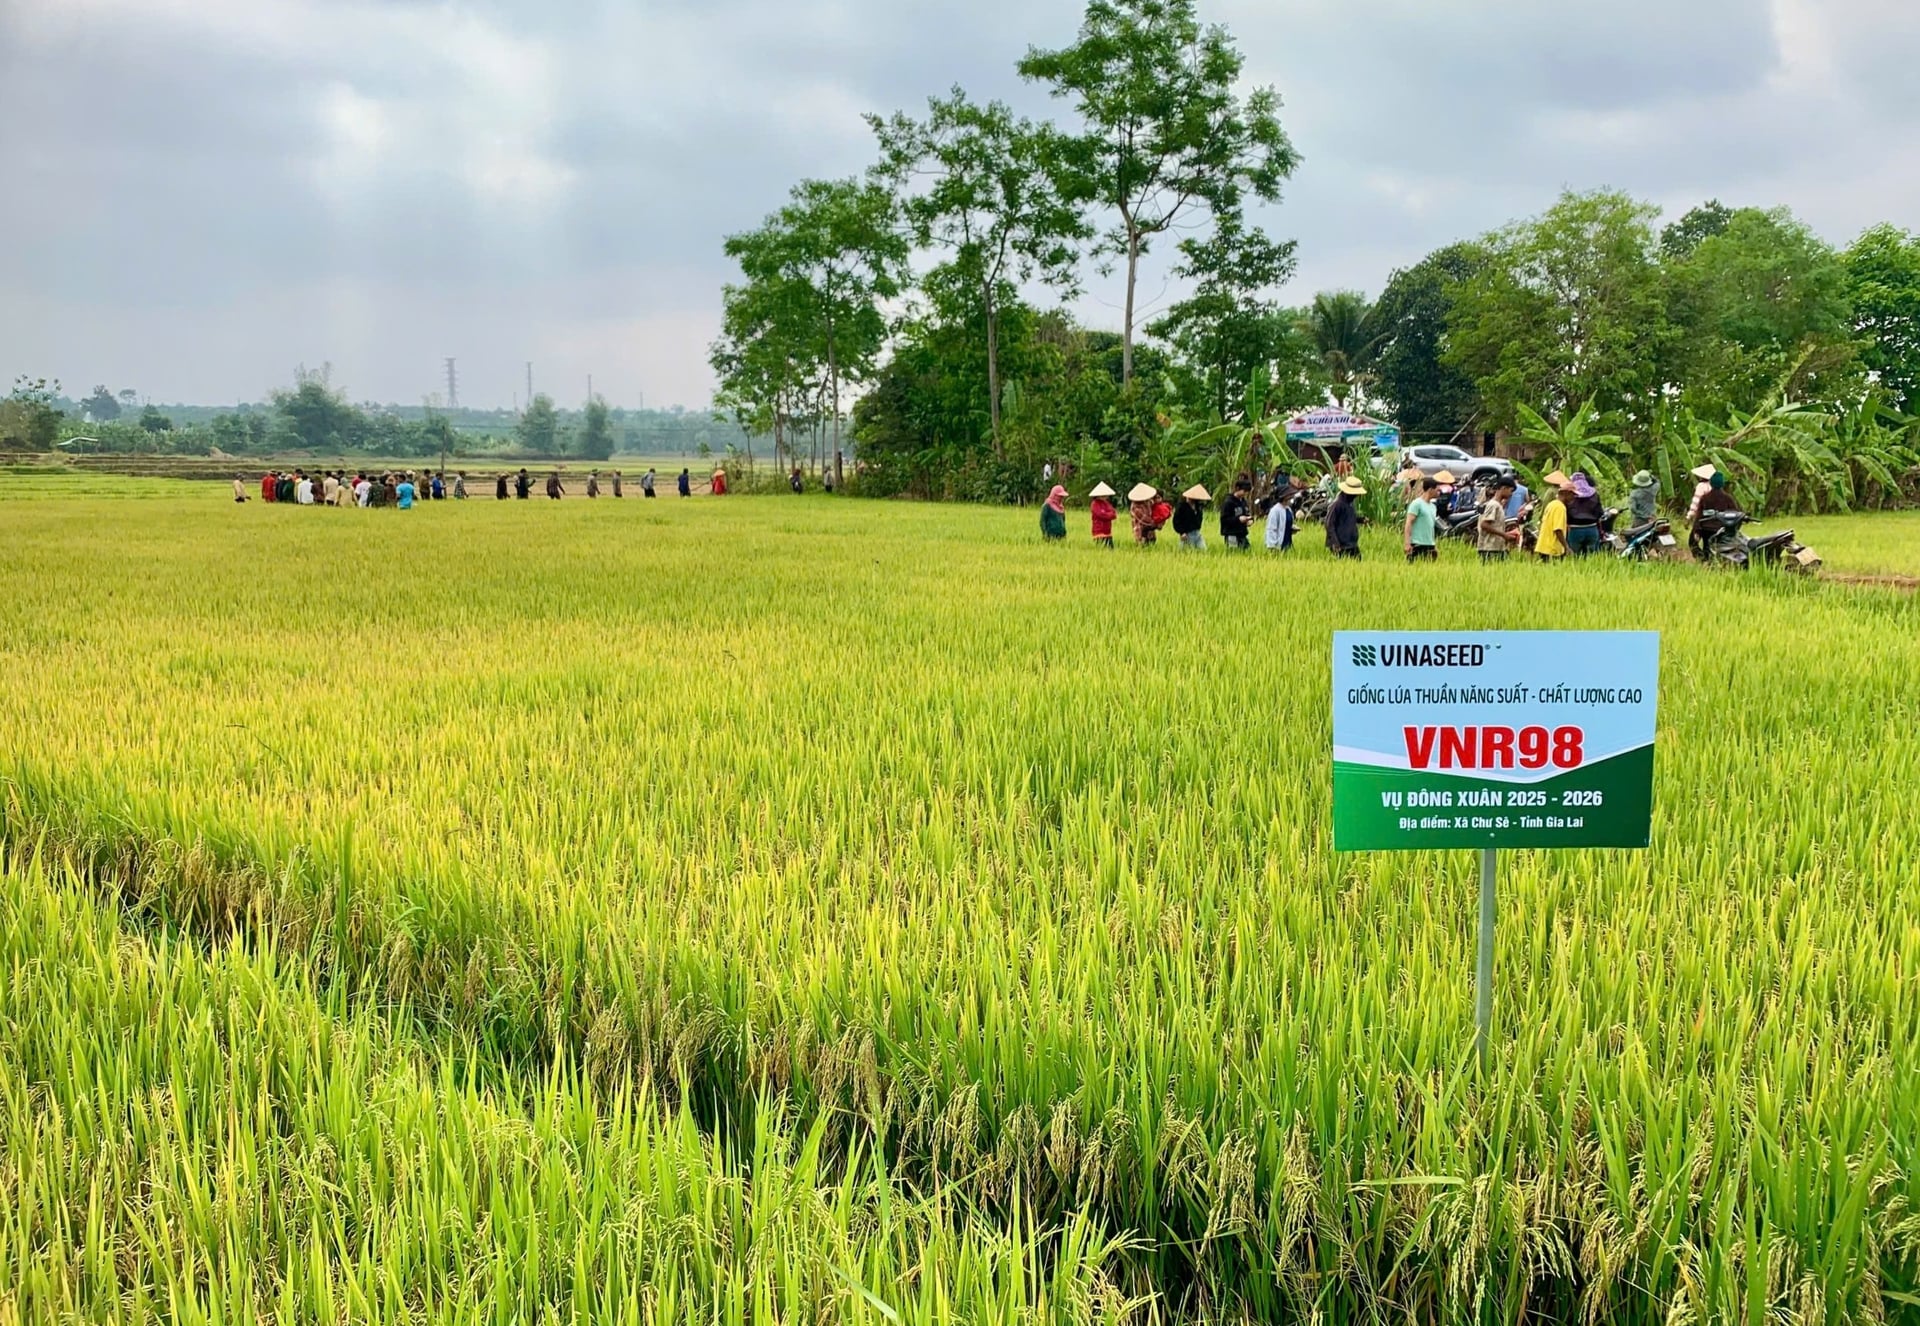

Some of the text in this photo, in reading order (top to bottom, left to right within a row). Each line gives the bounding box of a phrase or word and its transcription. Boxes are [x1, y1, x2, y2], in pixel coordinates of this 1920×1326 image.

[1348, 682, 1385, 704] GIỐNG
[1388, 685, 1411, 704] LÚA
[1415, 682, 1457, 704] THUẦN
[1460, 685, 1494, 704] NĂNG
[1497, 682, 1529, 704] SUẤT
[1538, 682, 1571, 704] CHẤT
[1574, 688, 1615, 707] LƯỢNG
[1618, 688, 1642, 704] CAO
[1403, 725, 1584, 770] VNR98
[1381, 791, 1402, 810] VỤ
[1407, 788, 1452, 807] ĐÔNG
[1457, 788, 1502, 807] XUÂN
[1507, 790, 1547, 806] 2025
[1562, 790, 1603, 806] 2026
[1399, 817, 1417, 831] Địa
[1420, 815, 1451, 829] điểm:
[1454, 817, 1468, 829] Xã
[1472, 817, 1493, 829] Chư
[1495, 816, 1510, 828] Sê
[1520, 815, 1543, 828] Tỉnh
[1546, 816, 1565, 828] Gia
[1567, 816, 1583, 828] Lai
